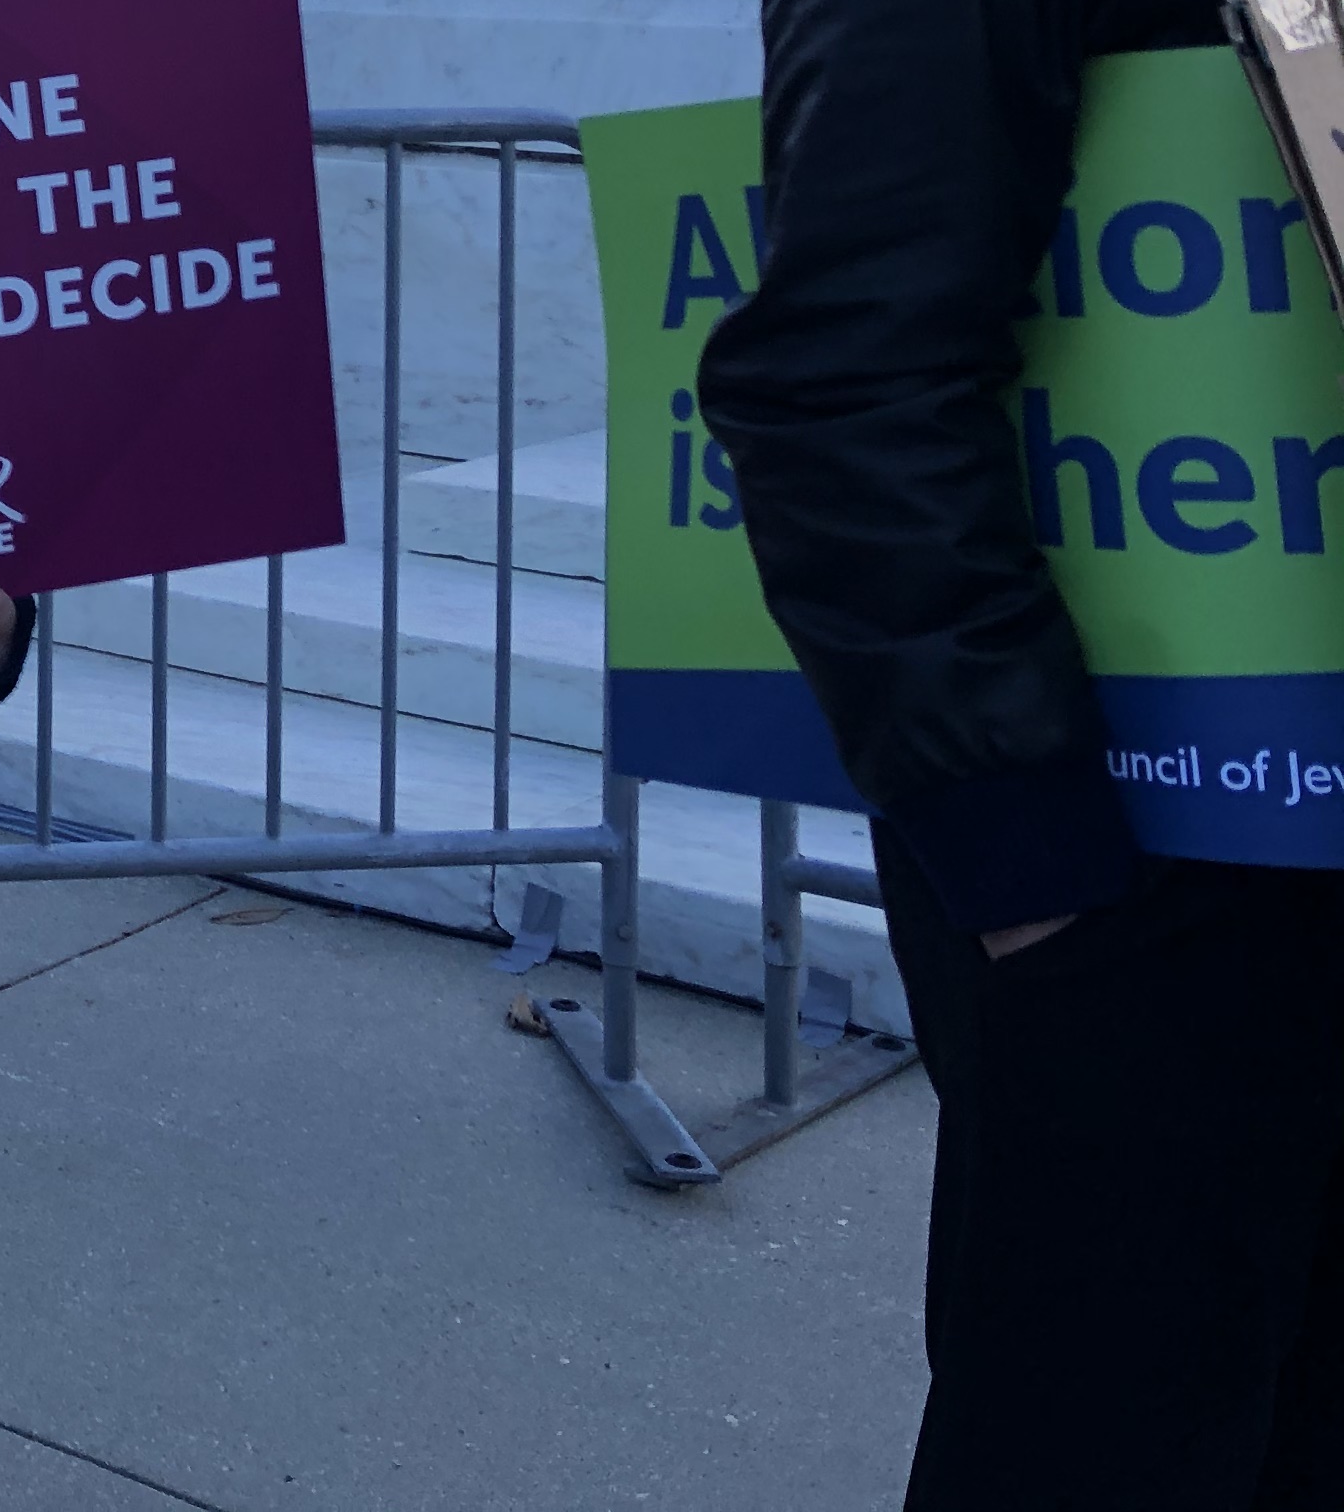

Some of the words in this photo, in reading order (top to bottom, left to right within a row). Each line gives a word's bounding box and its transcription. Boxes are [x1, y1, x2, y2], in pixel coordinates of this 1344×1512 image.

[17, 157, 182, 236] THE
[1107, 746, 1201, 787] uncil
[1220, 749, 1271, 792] of
[1285, 749, 1344, 806] Je
